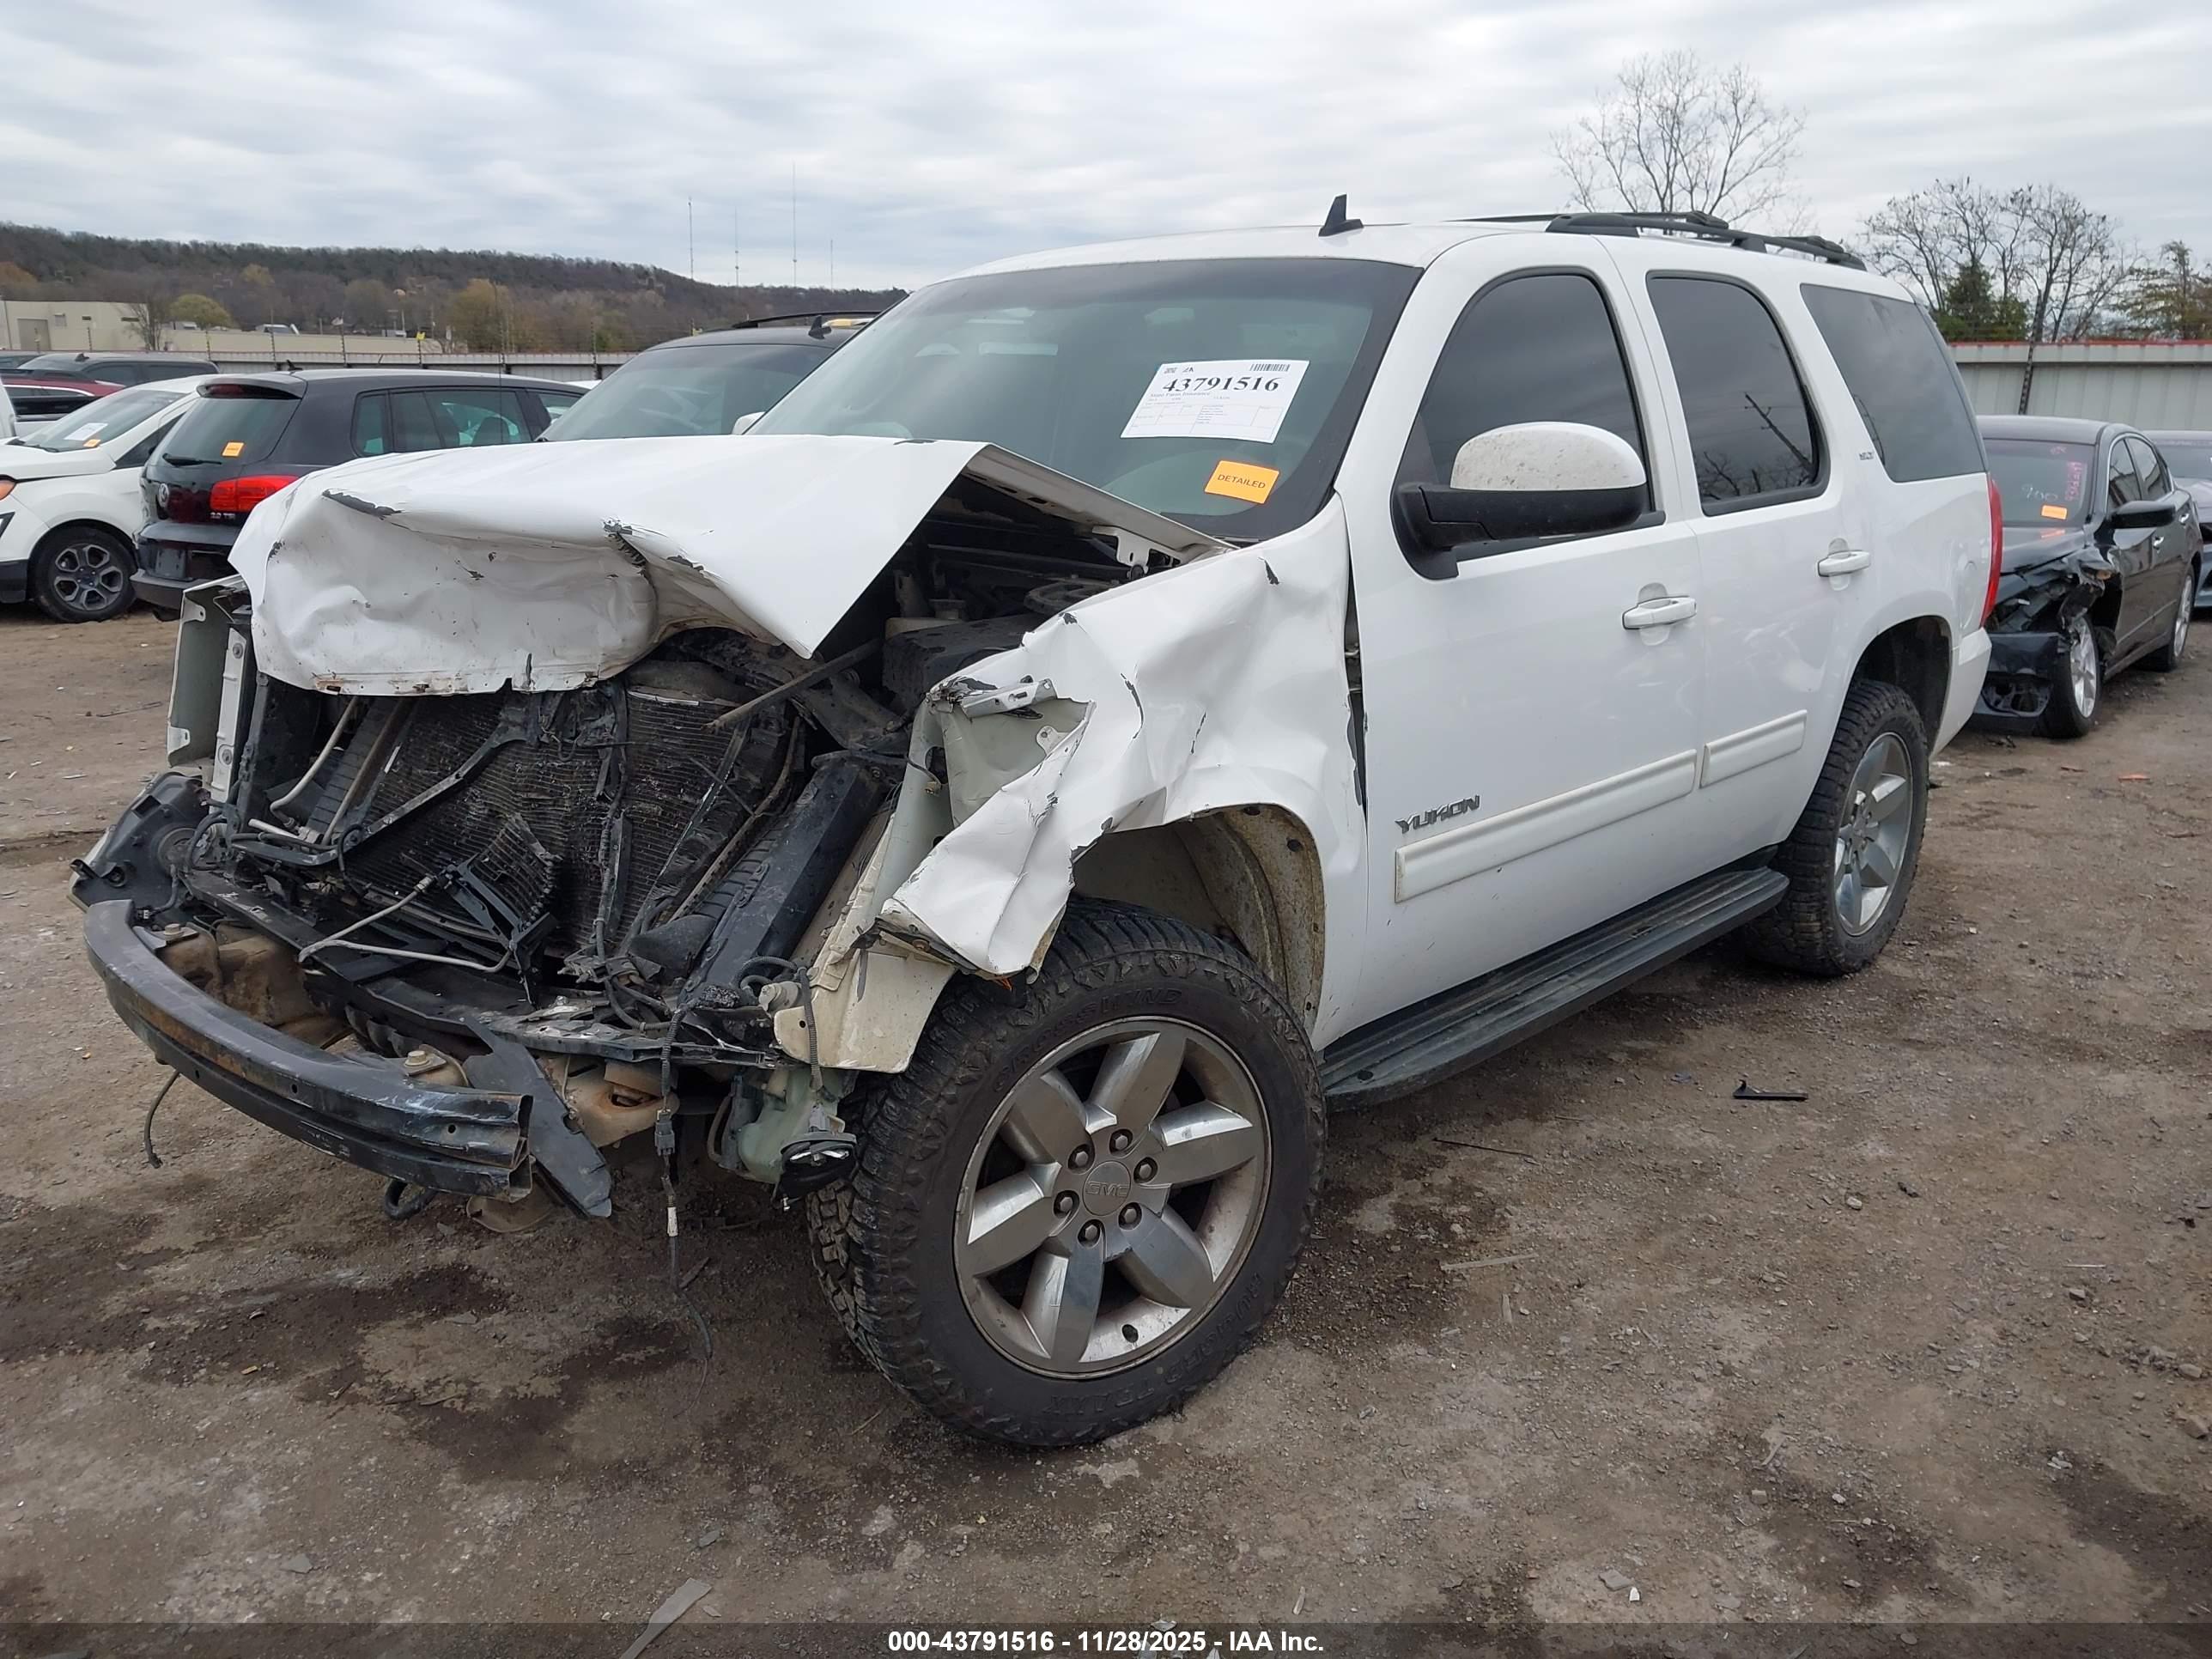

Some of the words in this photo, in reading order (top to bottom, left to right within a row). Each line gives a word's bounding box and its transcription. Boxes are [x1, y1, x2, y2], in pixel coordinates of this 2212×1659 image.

[1162, 376, 1284, 392] 43791516
[1217, 474, 1266, 489] DETAILED
[1395, 794, 1480, 835] YUKON
[1085, 1181, 1129, 1197] GMC
